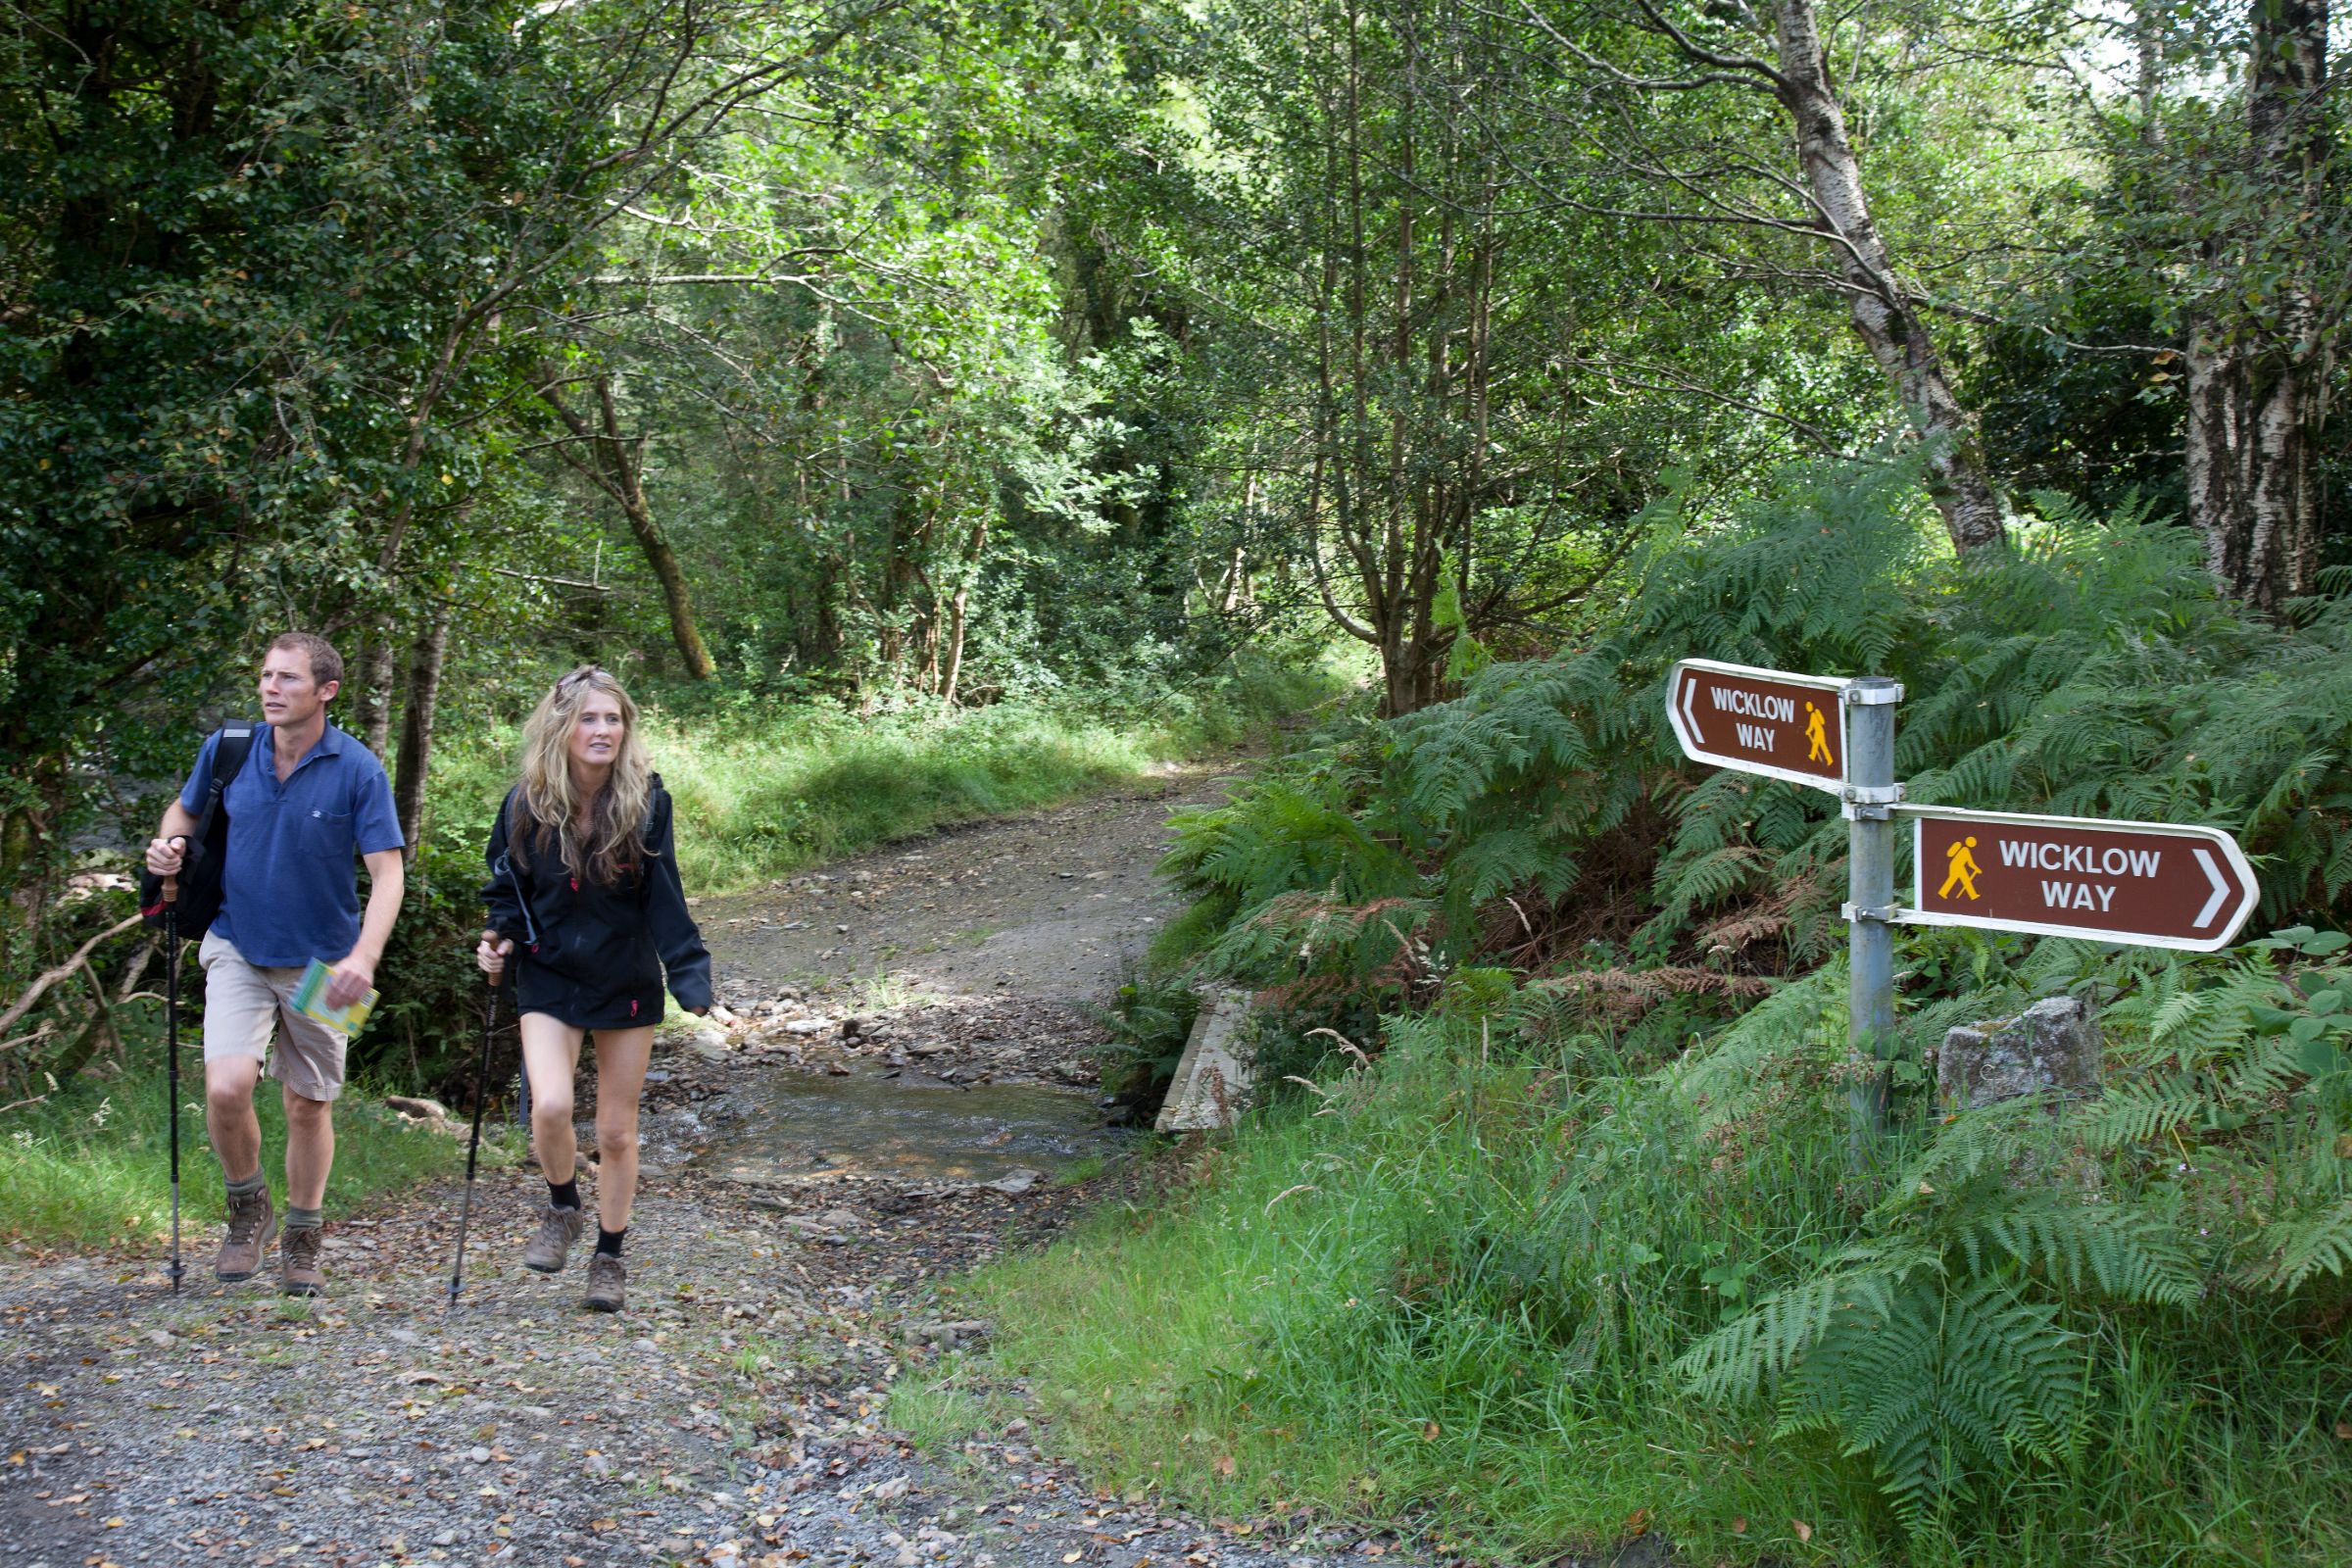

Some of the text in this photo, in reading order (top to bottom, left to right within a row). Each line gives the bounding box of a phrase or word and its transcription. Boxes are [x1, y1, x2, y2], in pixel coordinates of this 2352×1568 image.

[1710, 687, 1795, 723] WICKLOW
[1736, 723, 1776, 753] WAY
[1998, 839, 2161, 878] WICKLOW
[2040, 880, 2117, 912] WAY
